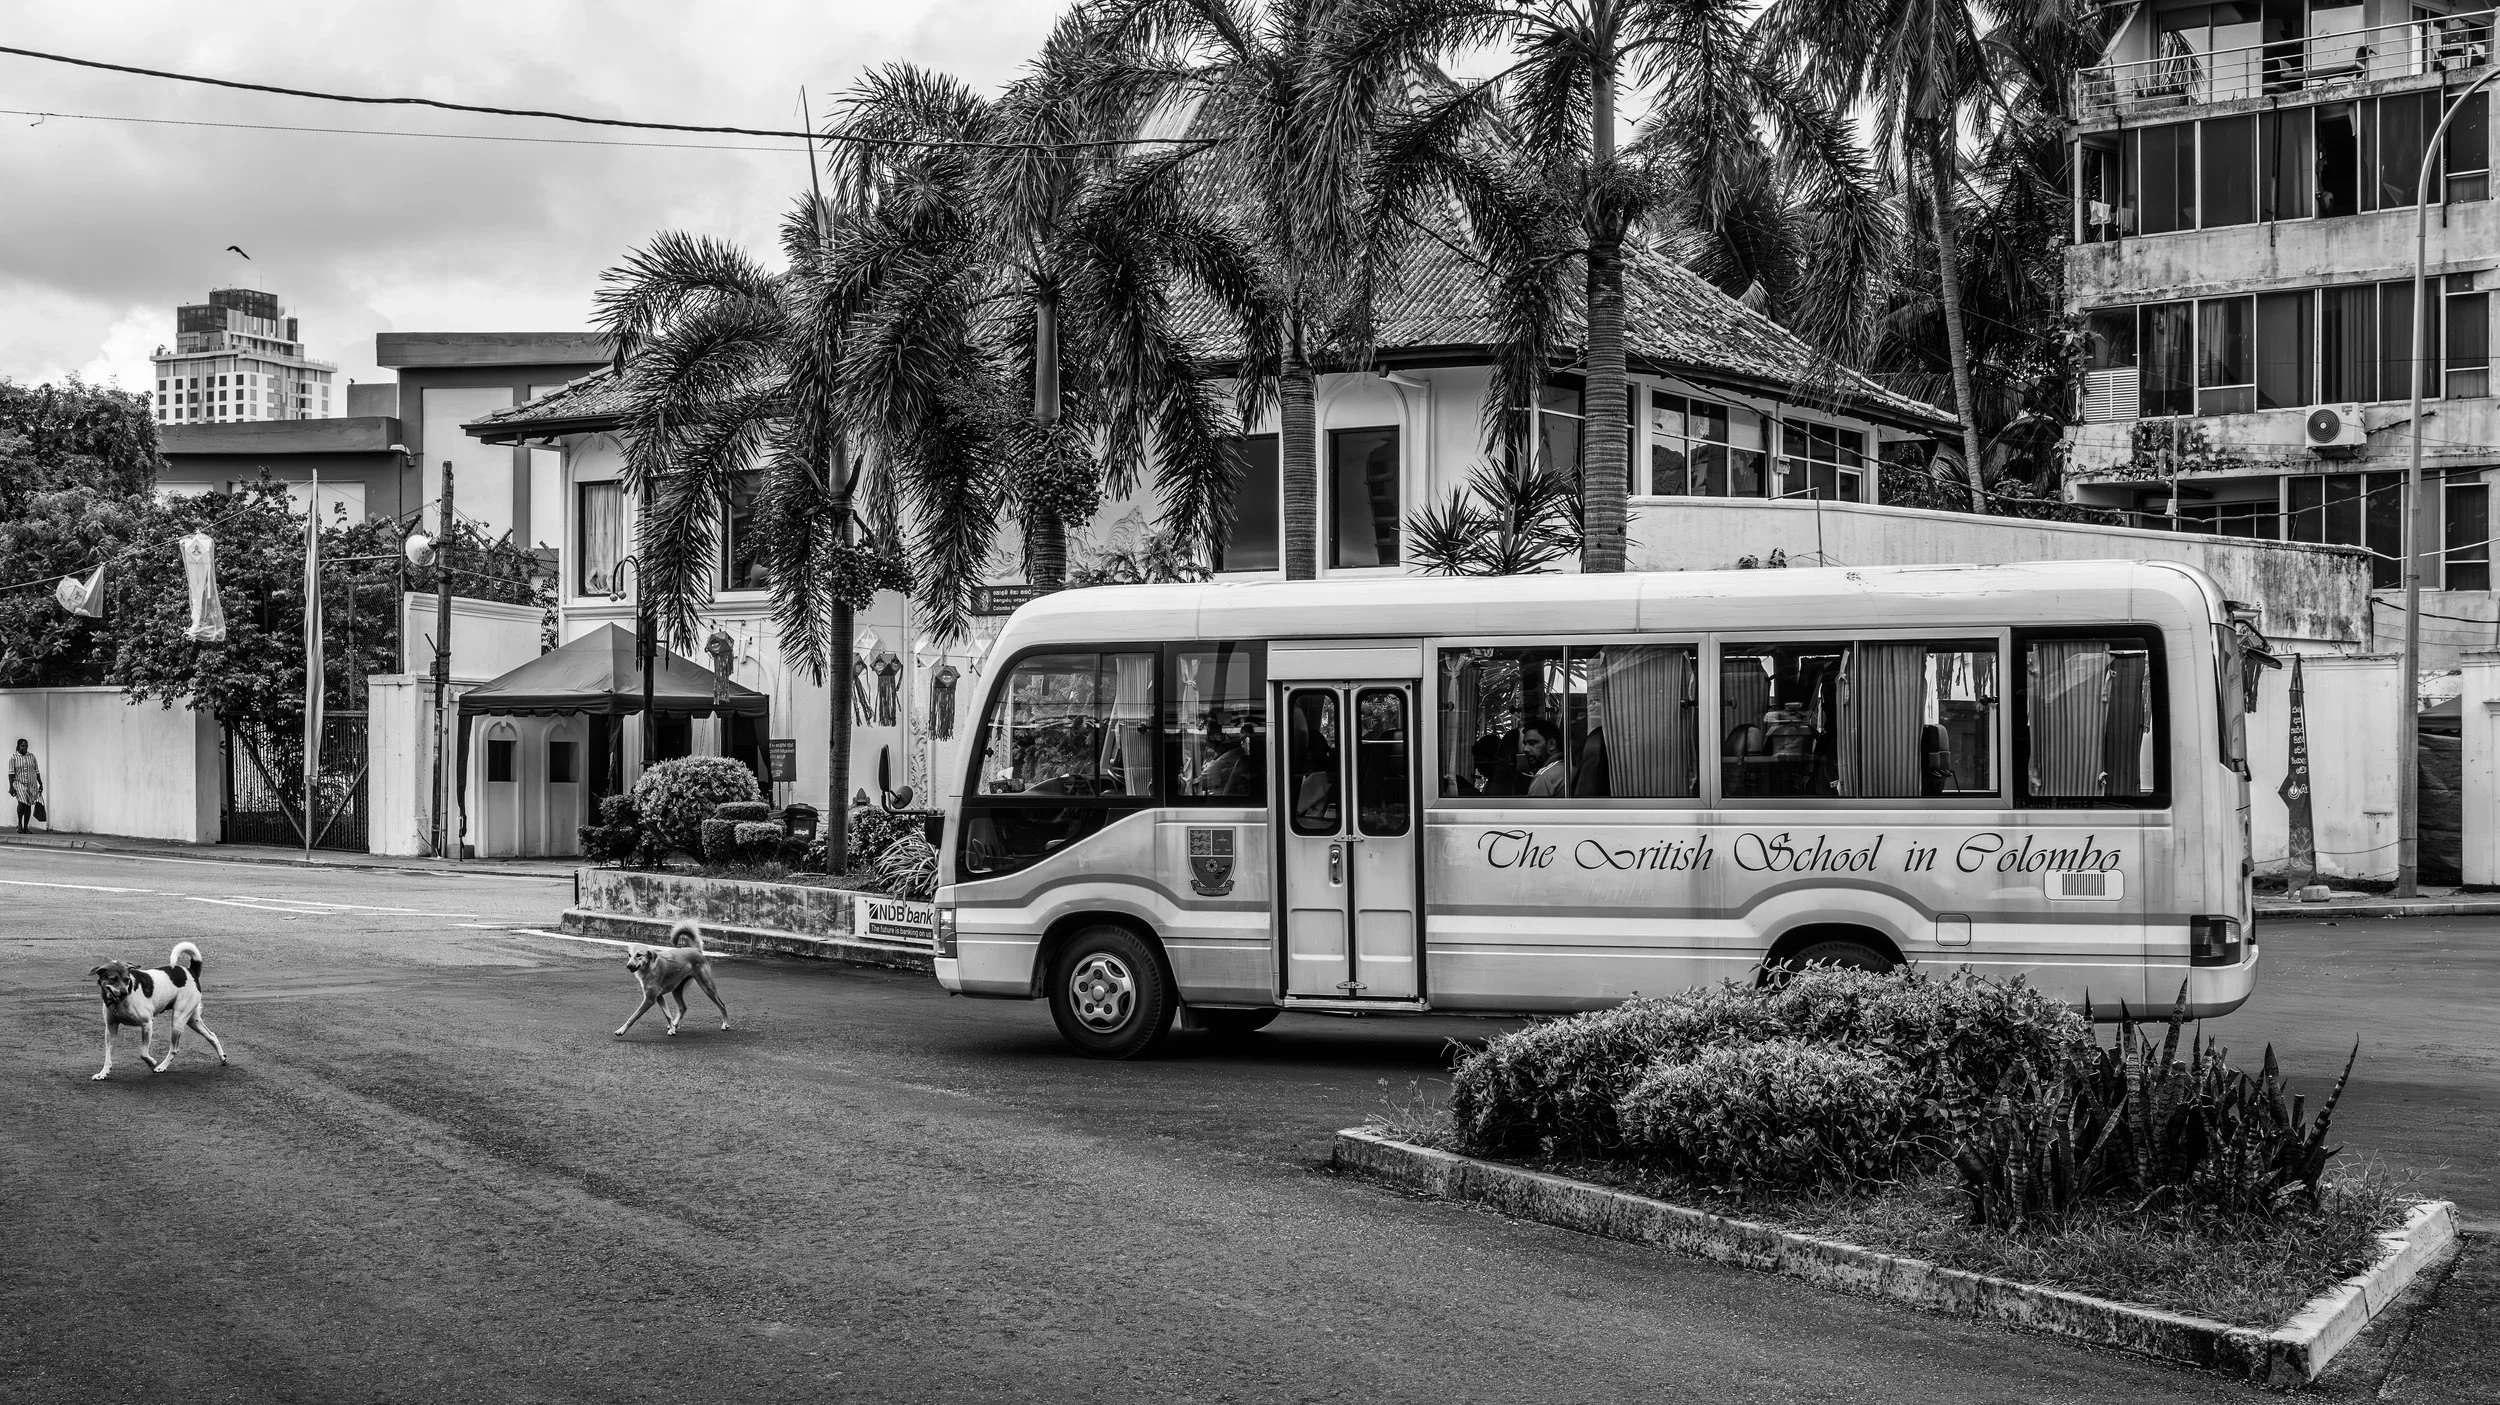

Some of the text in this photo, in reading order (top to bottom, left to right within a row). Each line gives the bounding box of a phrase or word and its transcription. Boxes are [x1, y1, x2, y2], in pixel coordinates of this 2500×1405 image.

[1478, 829, 1557, 869] The
[1734, 832, 1884, 872] School
[1904, 840, 1936, 872] in
[1956, 832, 2121, 873] Colombo
[879, 904, 934, 925] NDB bank
[871, 924, 879, 932] The
[900, 927, 919, 938] banking
